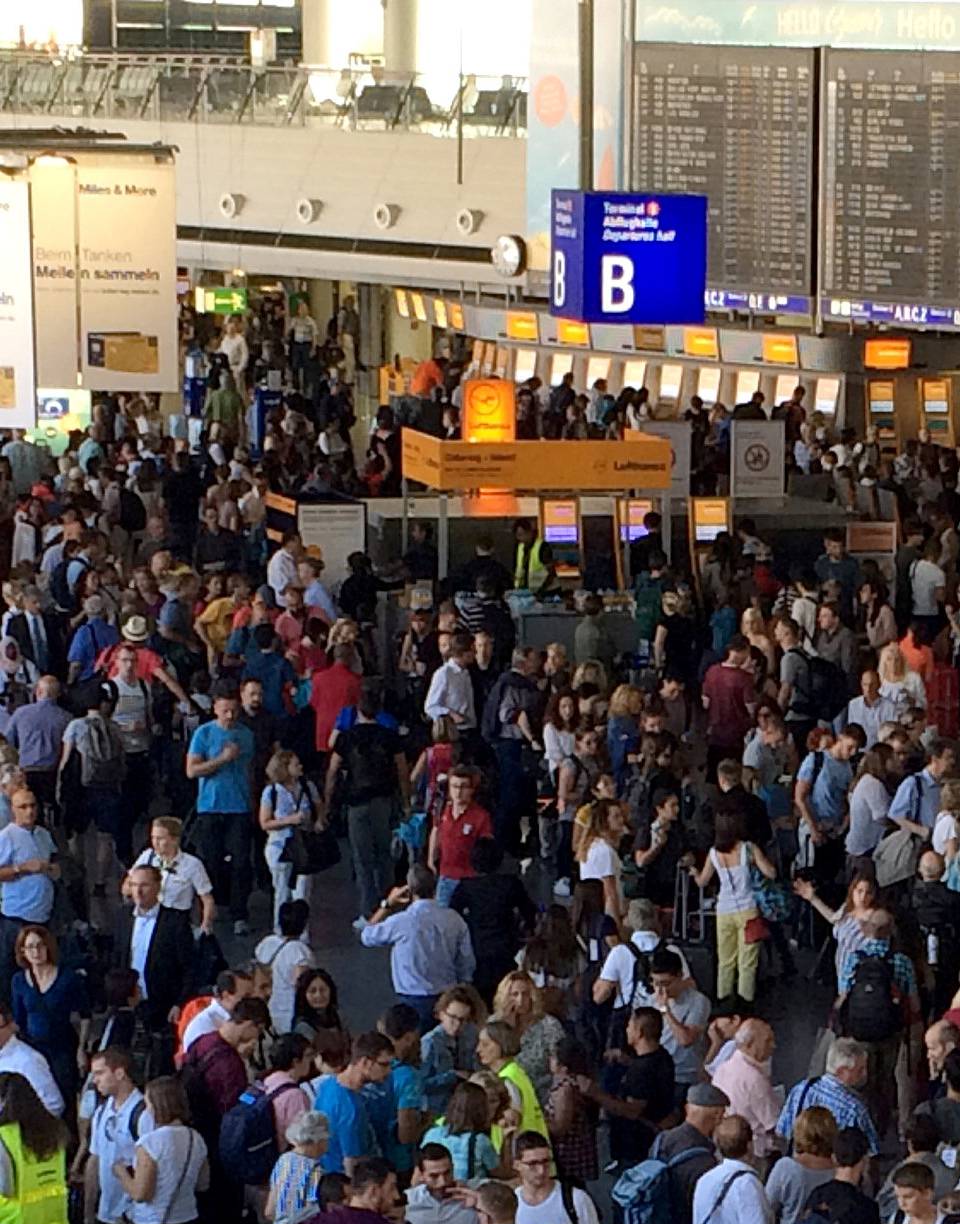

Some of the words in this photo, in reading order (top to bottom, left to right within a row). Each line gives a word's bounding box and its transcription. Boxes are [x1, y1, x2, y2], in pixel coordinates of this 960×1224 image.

[897, 8, 955, 39] Hello
[36, 247, 71, 261] Beim
[83, 249, 132, 262] Tanken
[94, 268, 160, 281] sammeln
[601, 254, 634, 313] B
